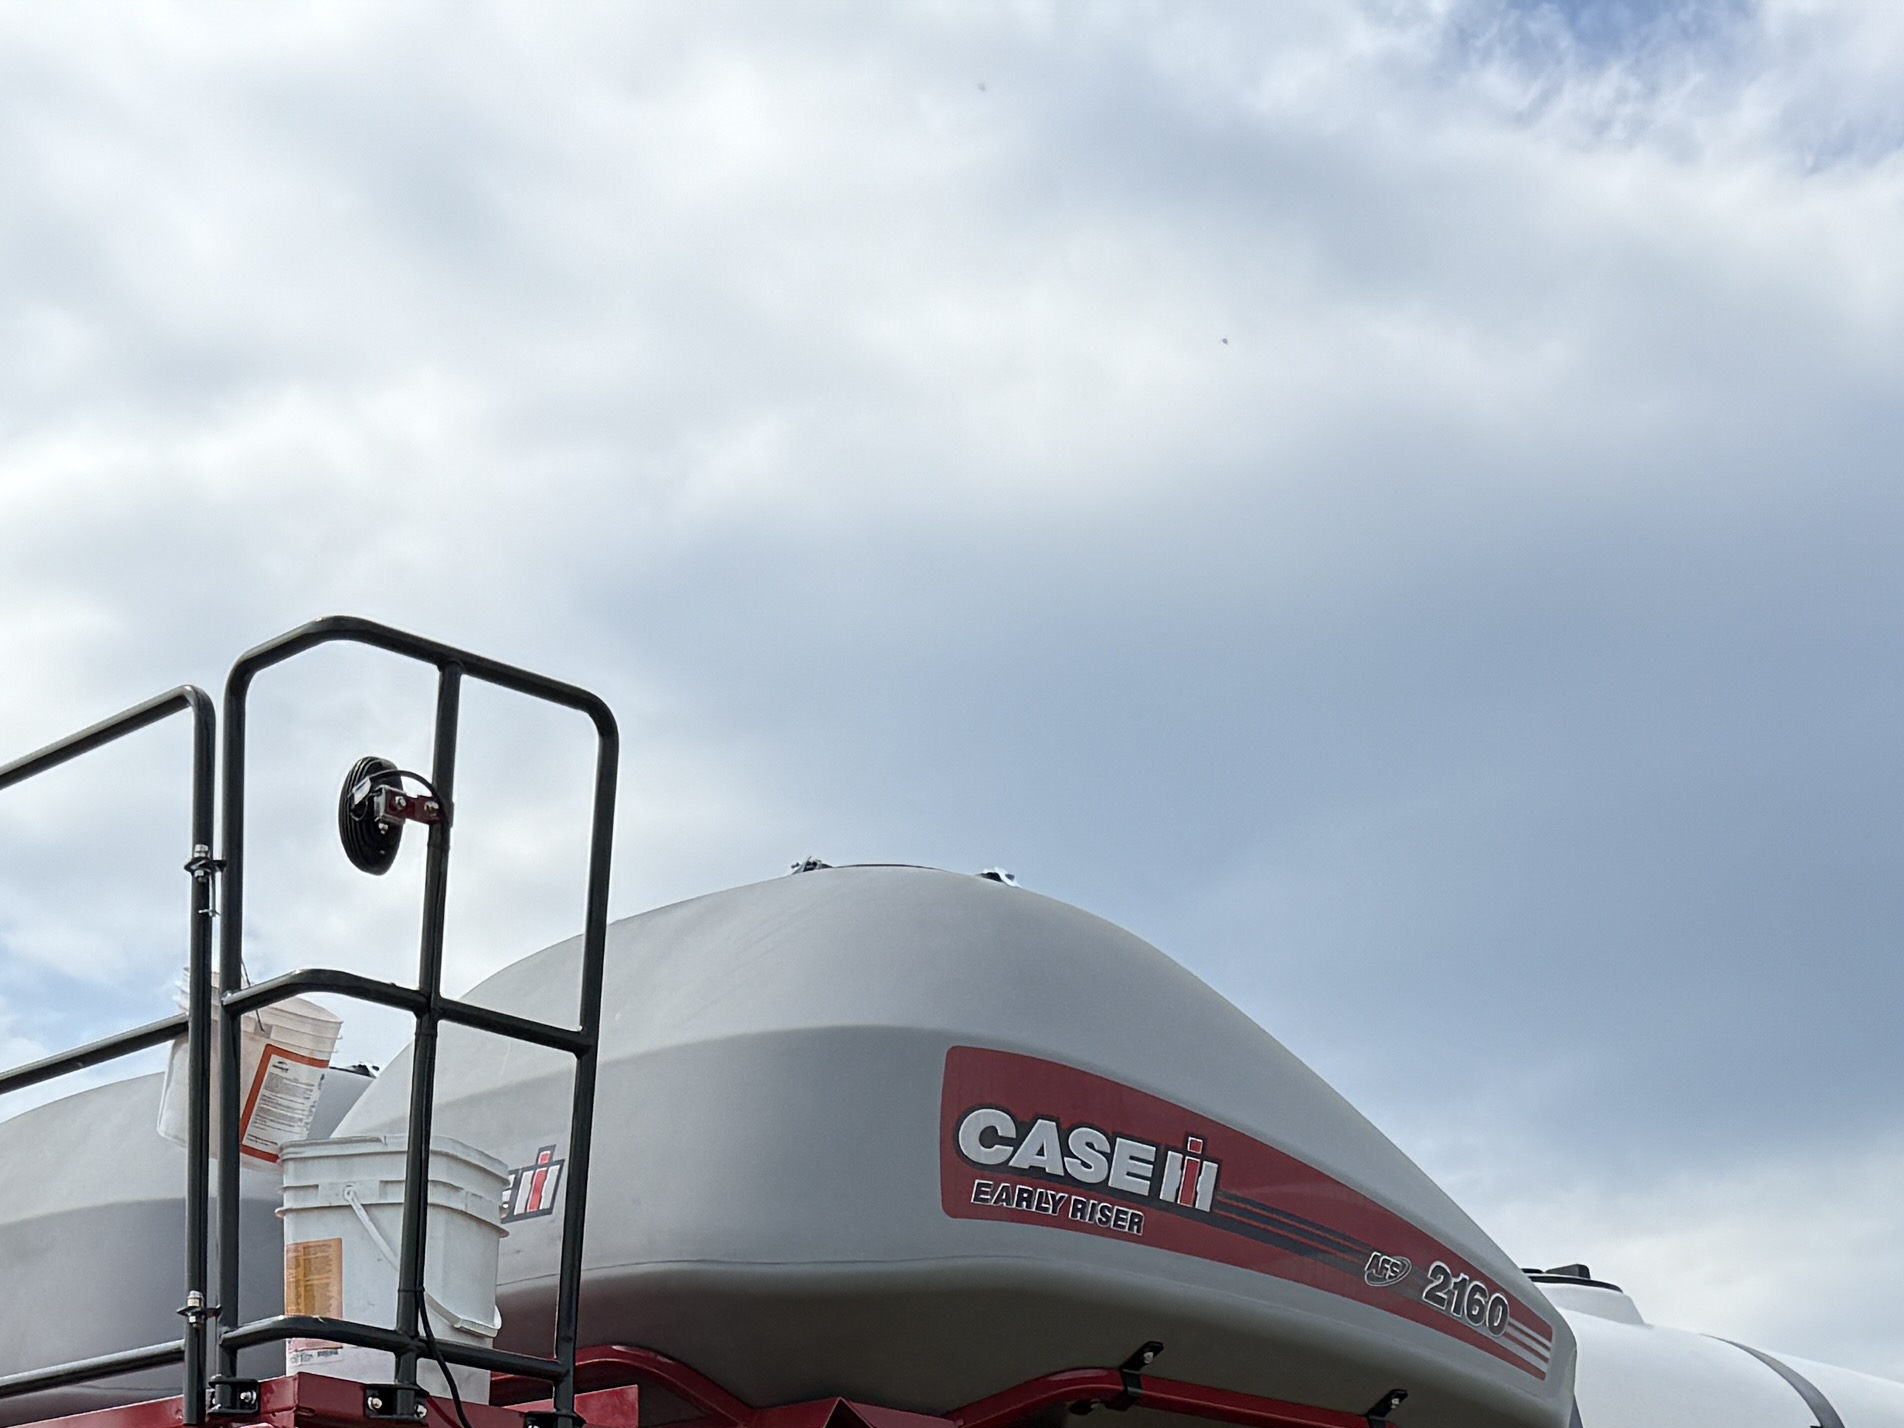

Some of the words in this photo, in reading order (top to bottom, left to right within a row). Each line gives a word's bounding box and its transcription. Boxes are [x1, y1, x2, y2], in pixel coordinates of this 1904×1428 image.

[958, 1108, 1156, 1196] CASE
[971, 1179, 1067, 1216] EARLY
[1069, 1195, 1144, 1236] RISER
[1365, 1251, 1402, 1281] AFS
[1422, 1261, 1510, 1337] 2160
